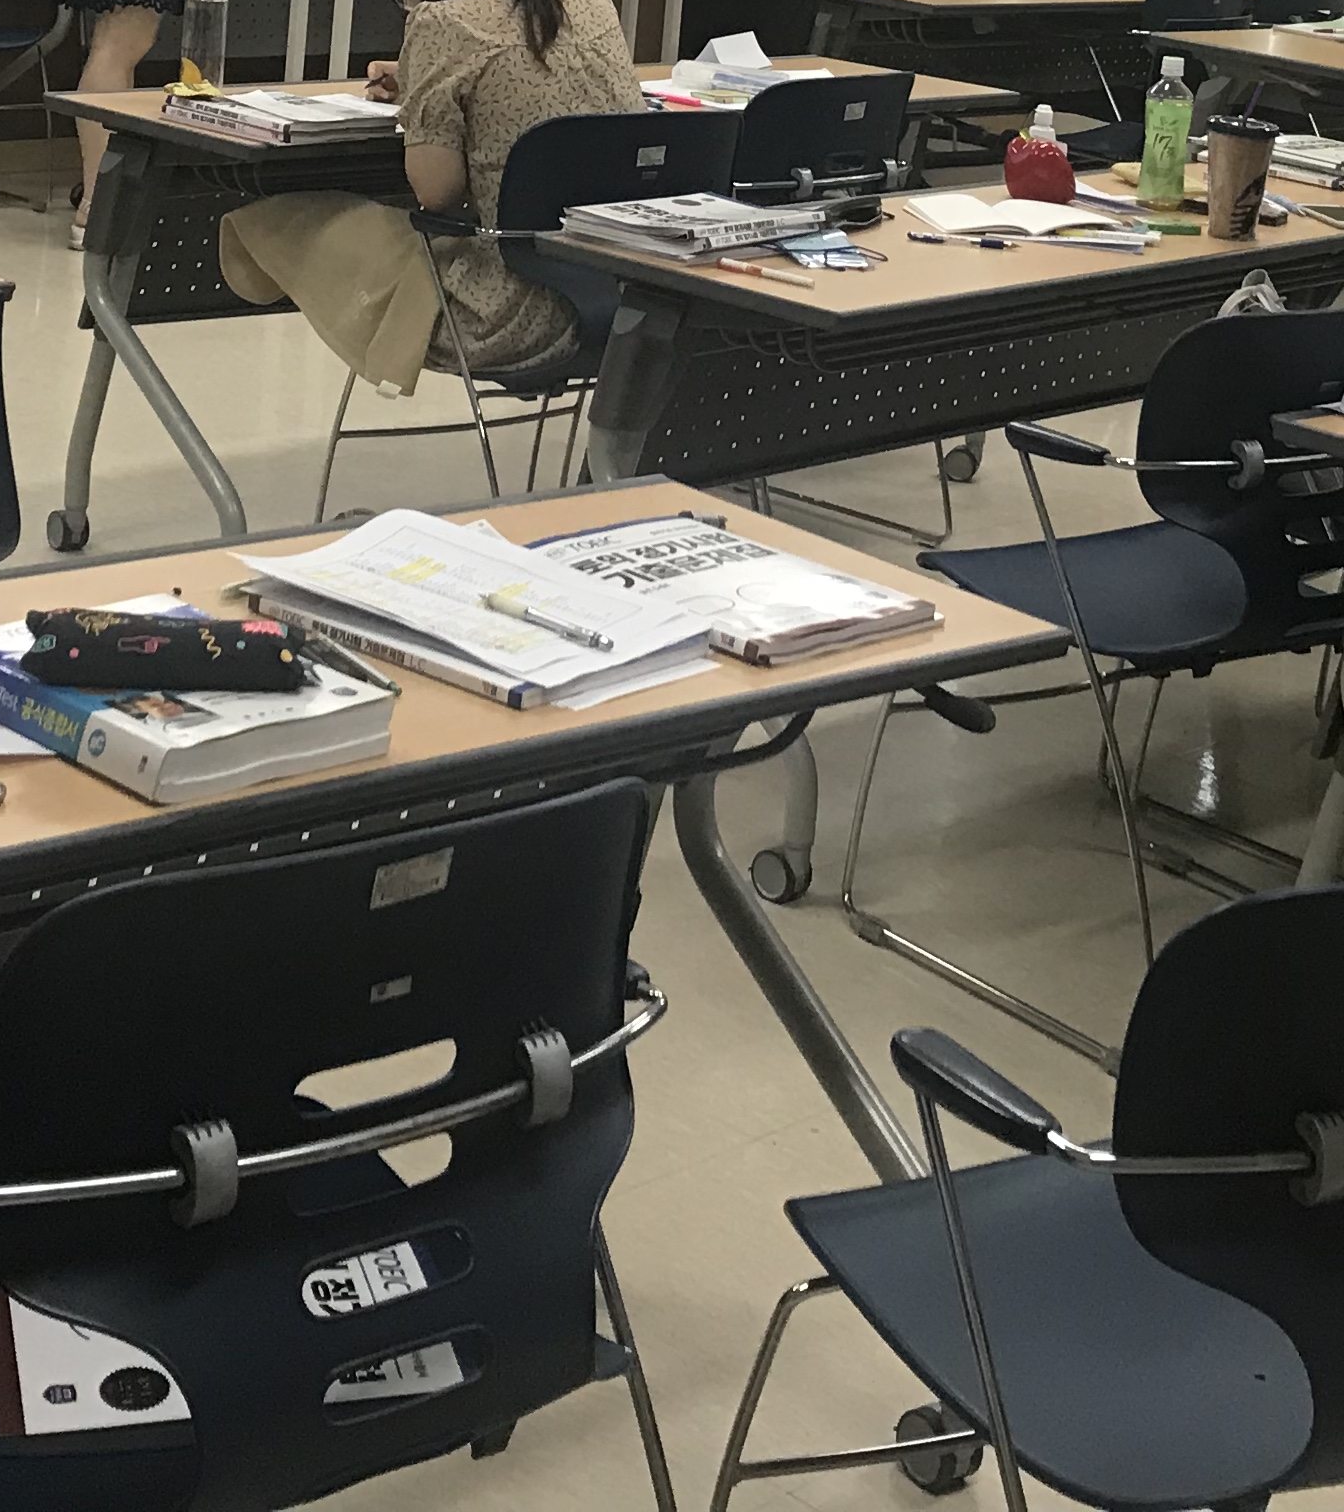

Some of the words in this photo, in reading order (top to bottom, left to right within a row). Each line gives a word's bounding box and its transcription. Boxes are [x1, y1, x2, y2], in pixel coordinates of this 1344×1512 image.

[570, 551, 638, 575] 토익
[628, 531, 742, 559] 정기시험
[602, 542, 780, 589] 기출문제집
[20, 695, 80, 742] 공식종합서
